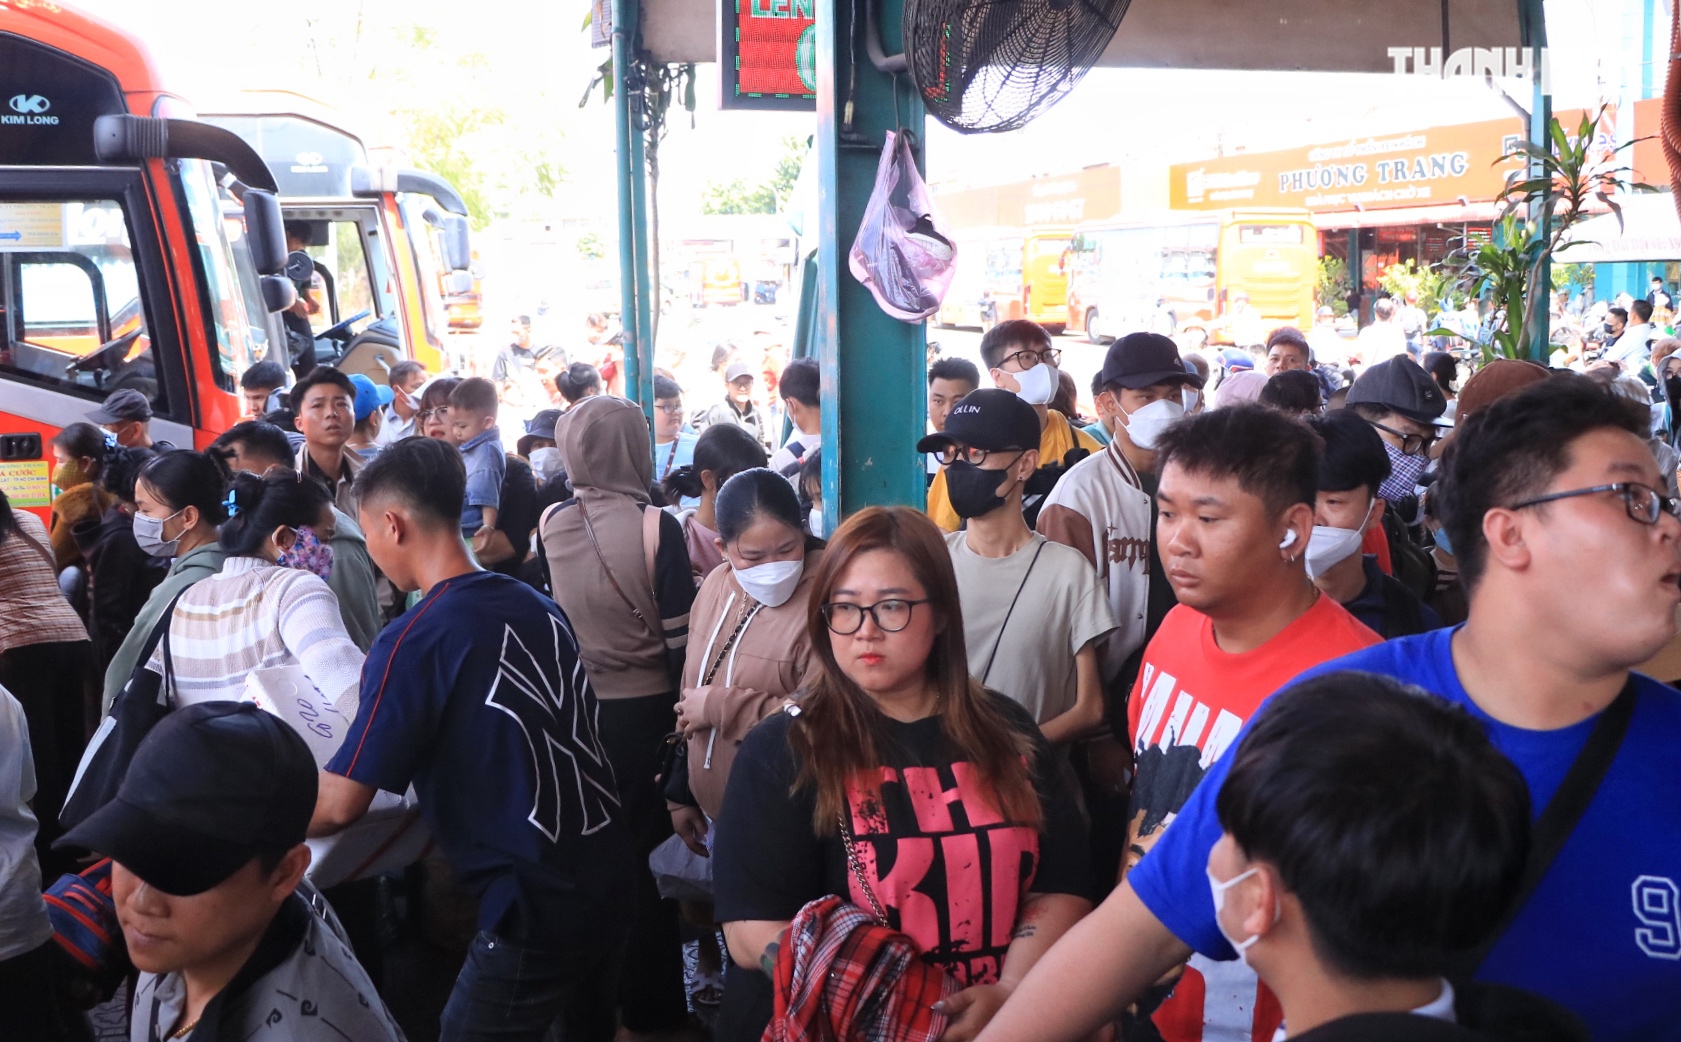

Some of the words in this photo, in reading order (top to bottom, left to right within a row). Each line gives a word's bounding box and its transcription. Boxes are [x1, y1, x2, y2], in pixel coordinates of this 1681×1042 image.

[1, 115, 25, 125] KIM
[26, 115, 60, 125] LONG
[1376, 152, 1469, 182] TRANG
[1631, 874, 1681, 960] 9
